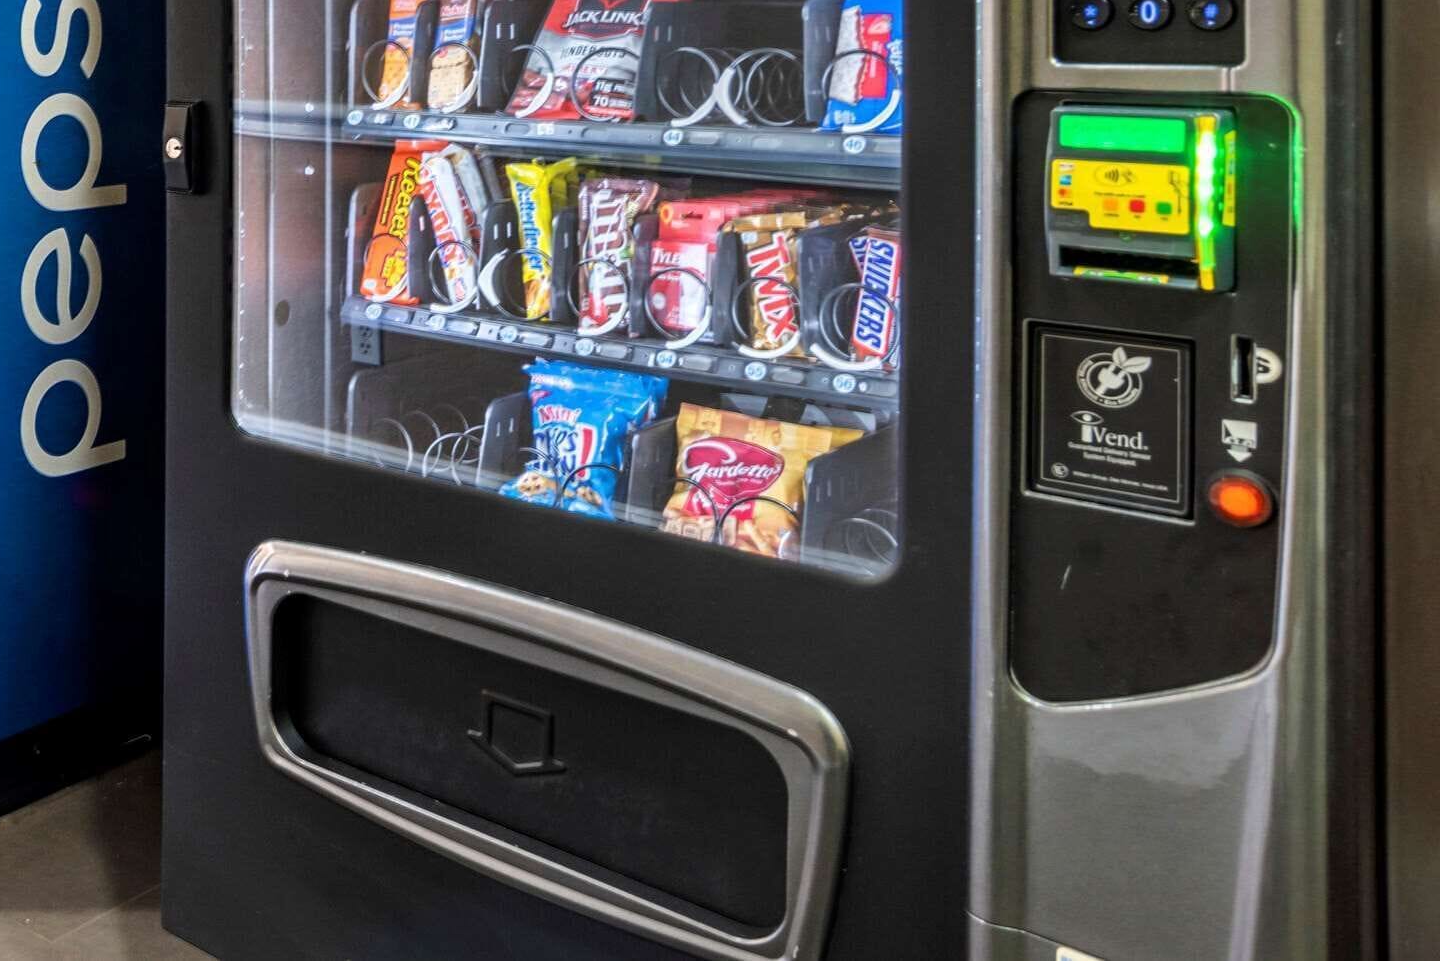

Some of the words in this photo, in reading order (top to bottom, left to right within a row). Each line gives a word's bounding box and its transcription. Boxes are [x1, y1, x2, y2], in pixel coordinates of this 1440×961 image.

[562, 9, 597, 29] JACK
[1139, 0, 1158, 23] 0
[746, 232, 798, 343] TWIX
[855, 238, 896, 351] SNICKERS
